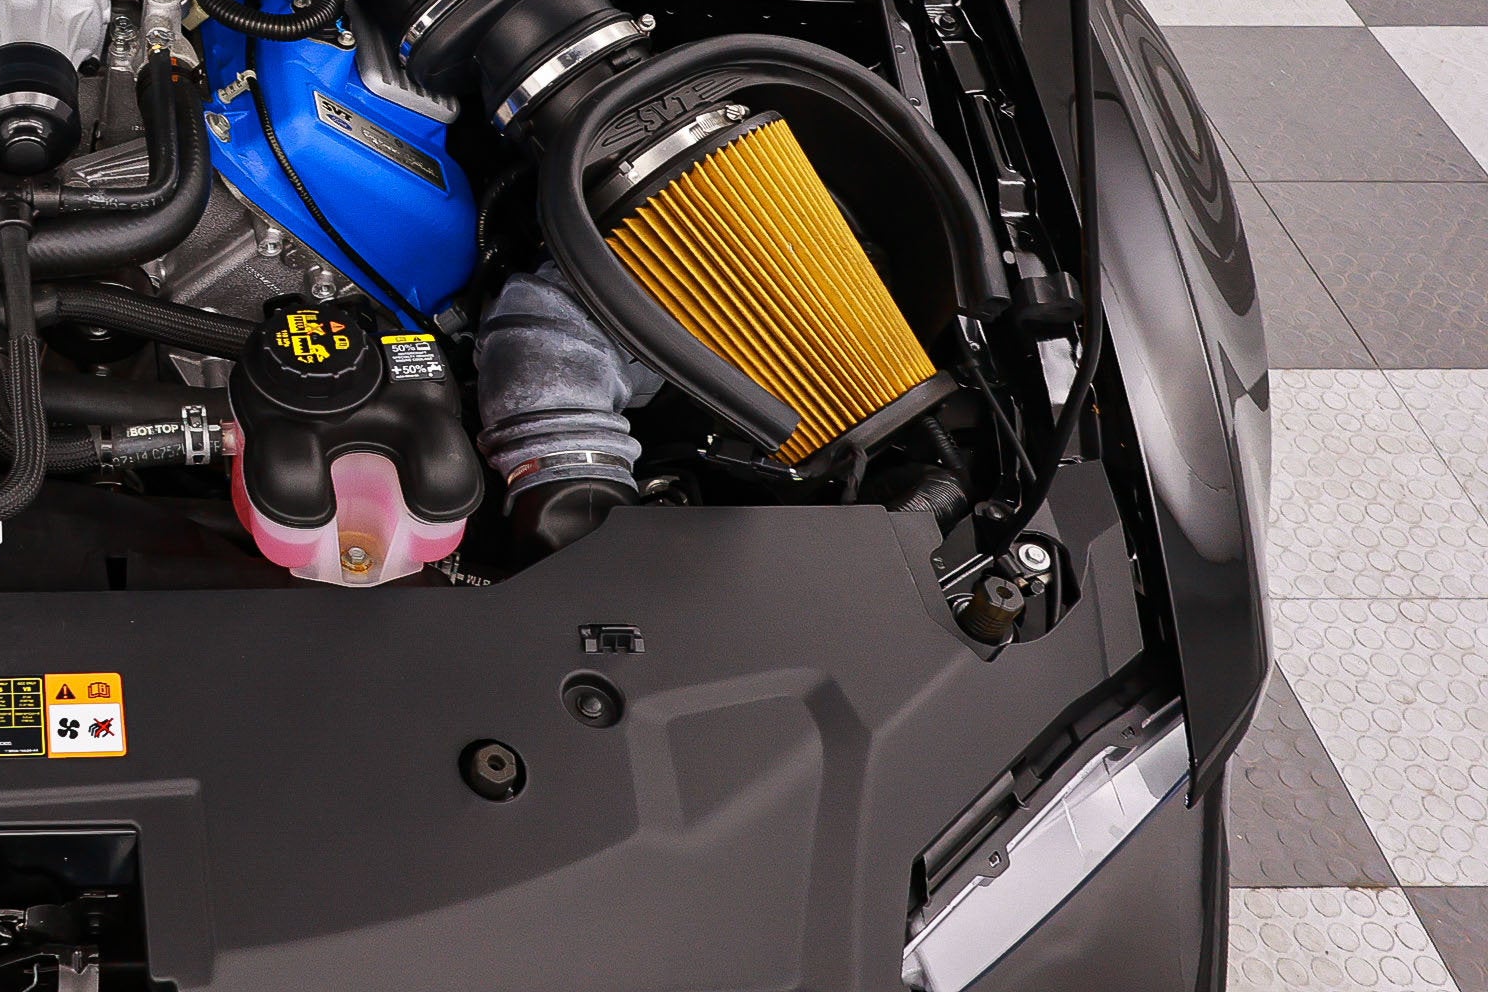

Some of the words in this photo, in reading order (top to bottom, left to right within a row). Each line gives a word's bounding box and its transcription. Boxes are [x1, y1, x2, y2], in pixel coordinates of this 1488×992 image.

[321, 100, 353, 122] SVT
[637, 87, 696, 133] SVT
[391, 344, 416, 353] 50%
[154, 424, 179, 434] TOP
